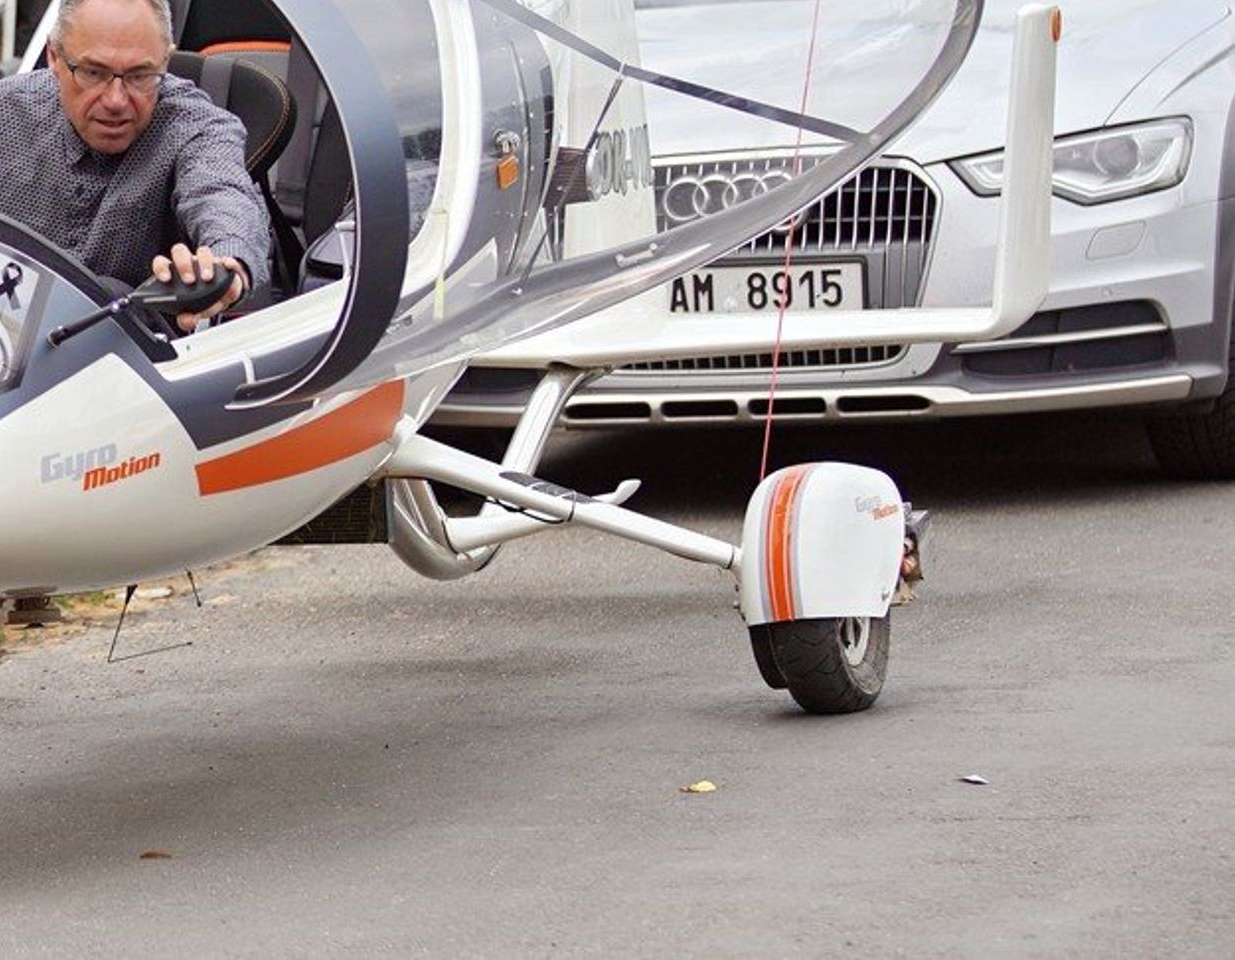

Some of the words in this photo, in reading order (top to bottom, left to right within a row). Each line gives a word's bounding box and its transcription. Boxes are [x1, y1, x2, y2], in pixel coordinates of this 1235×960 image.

[670, 273, 714, 313] AM
[747, 269, 843, 310] 8915
[41, 443, 117, 483] Gyro
[82, 452, 161, 492] Motion
